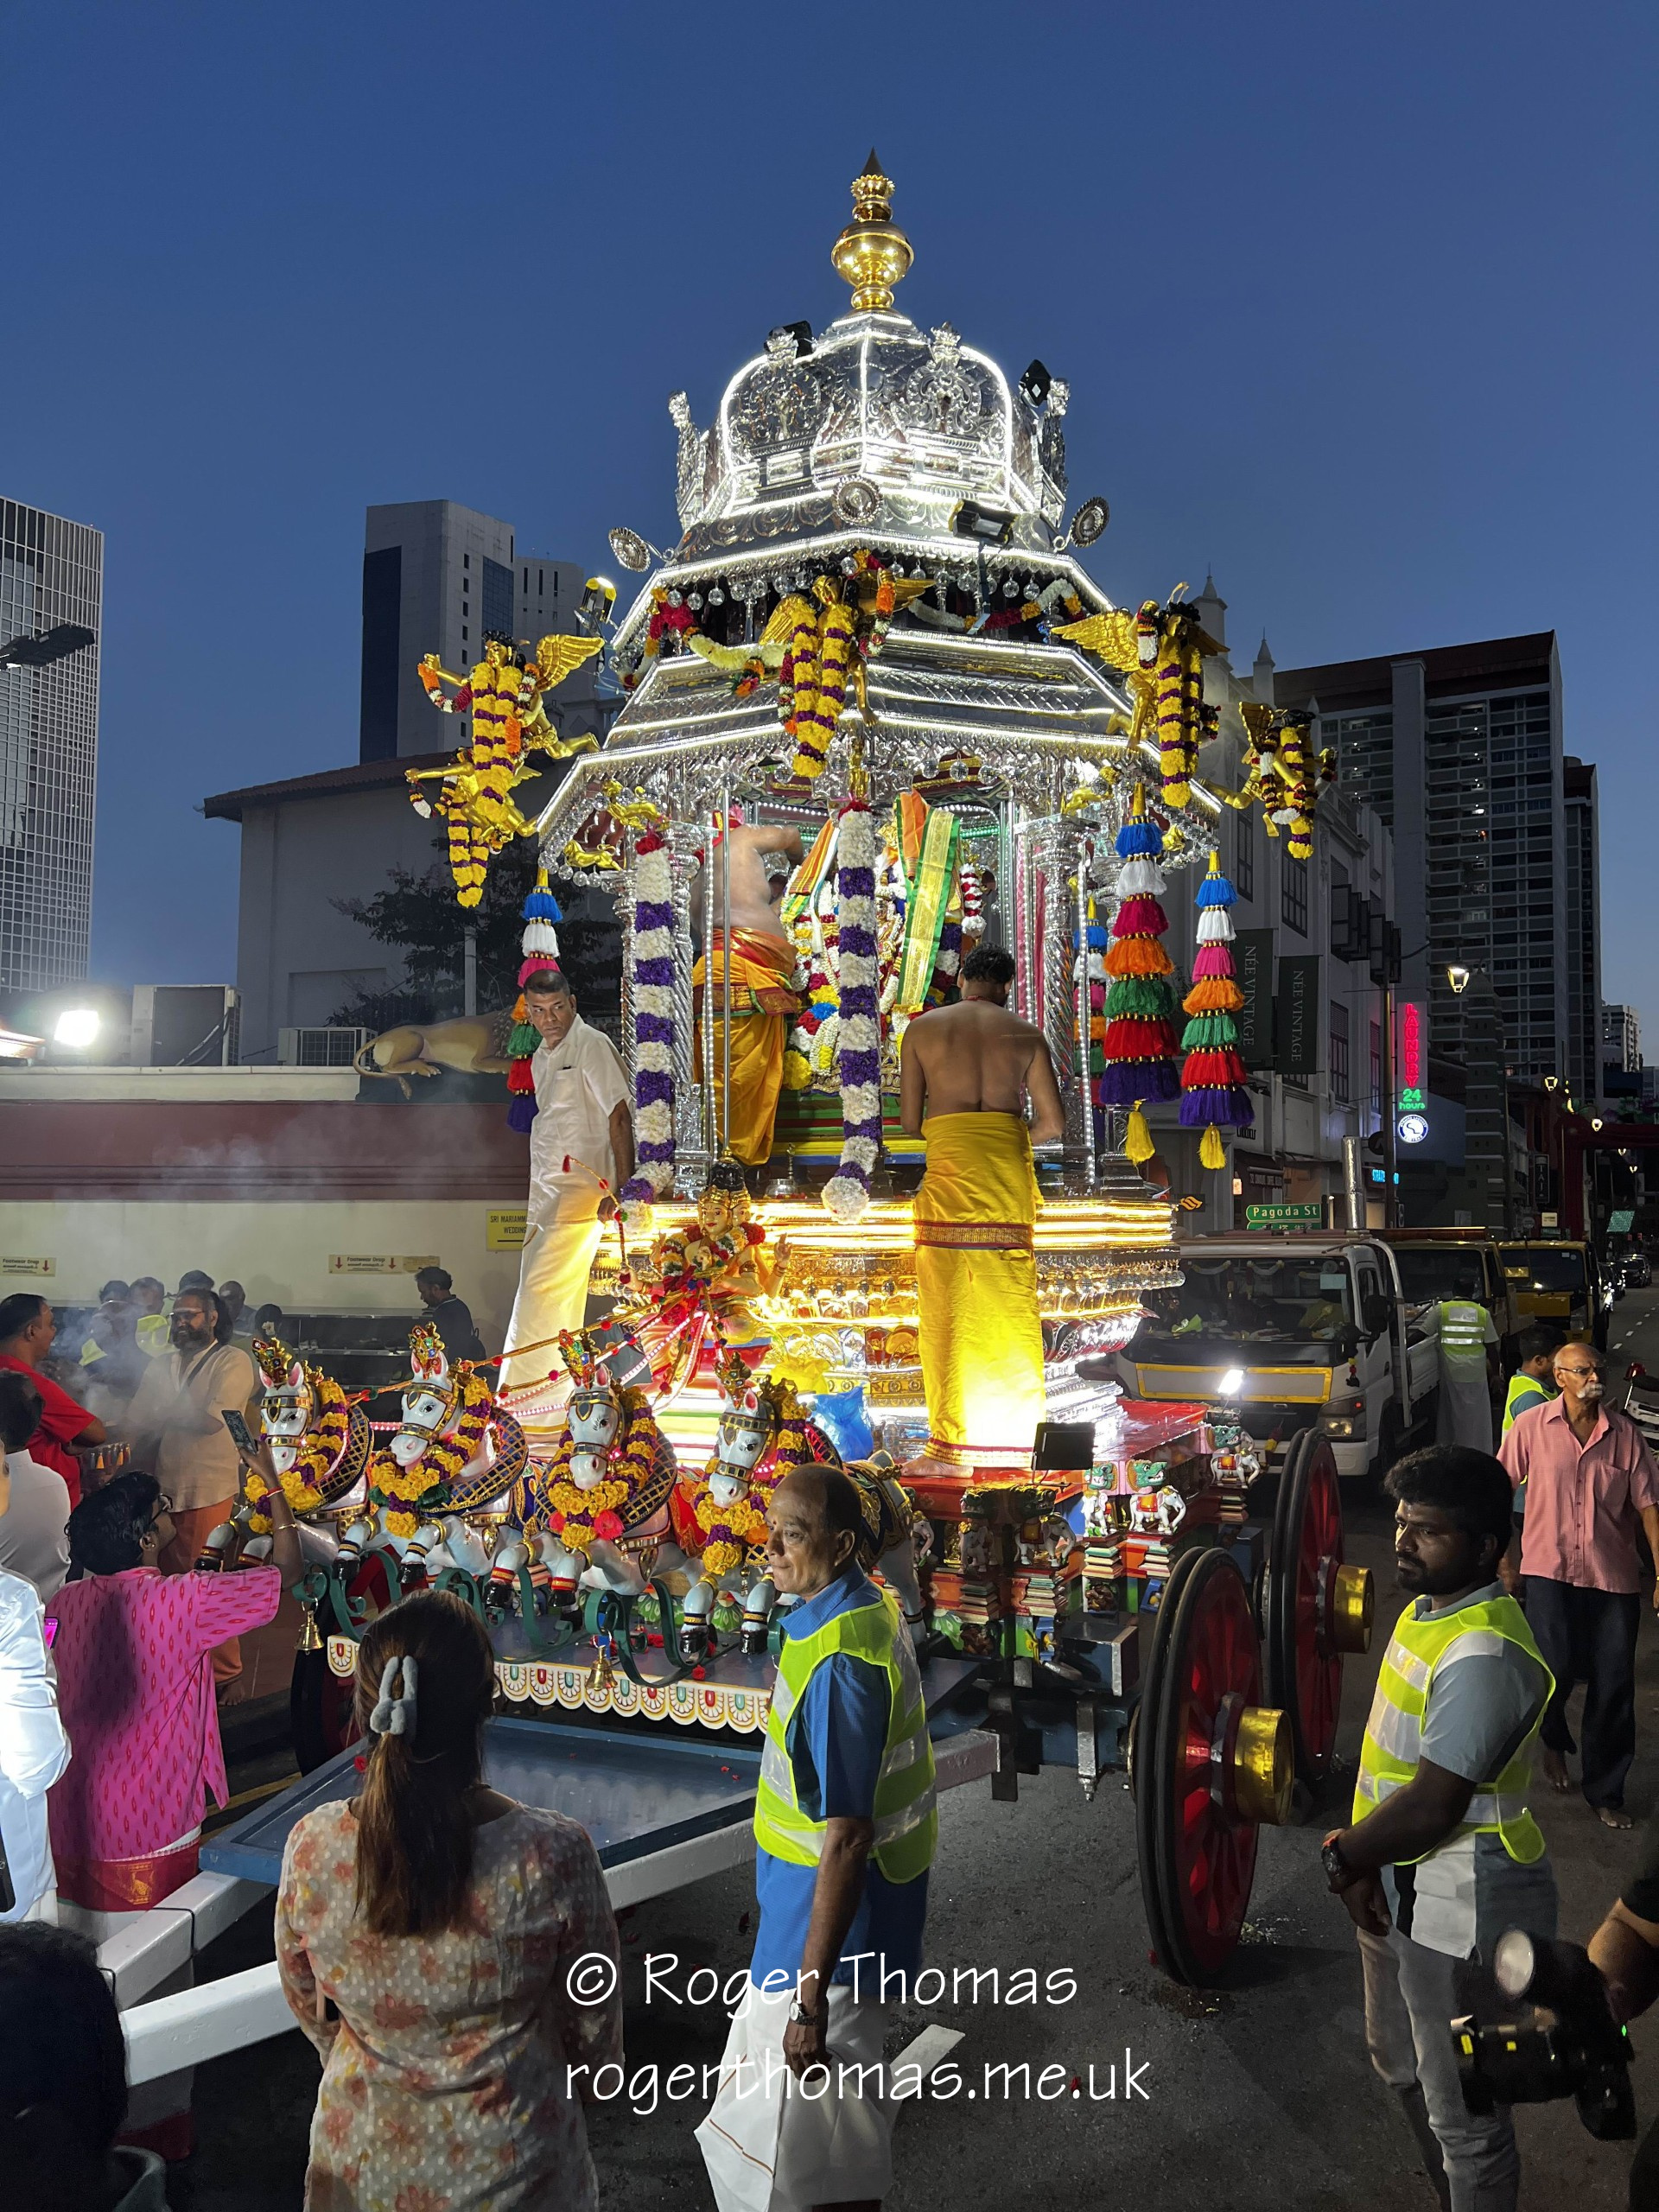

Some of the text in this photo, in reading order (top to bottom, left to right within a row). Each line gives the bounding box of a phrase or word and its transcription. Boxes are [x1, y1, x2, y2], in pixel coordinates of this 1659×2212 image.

[1243, 978, 1256, 1046] VINTAGE
[1291, 1000, 1303, 1063] VINTAGE
[1404, 1003, 1419, 1088] LAUNDRY
[1402, 1088, 1422, 1103] 24
[1398, 1102, 1426, 1110] hours
[490, 1215, 527, 1224] SRI MARIAMM
[1253, 1205, 1318, 1219] Pagoda St
